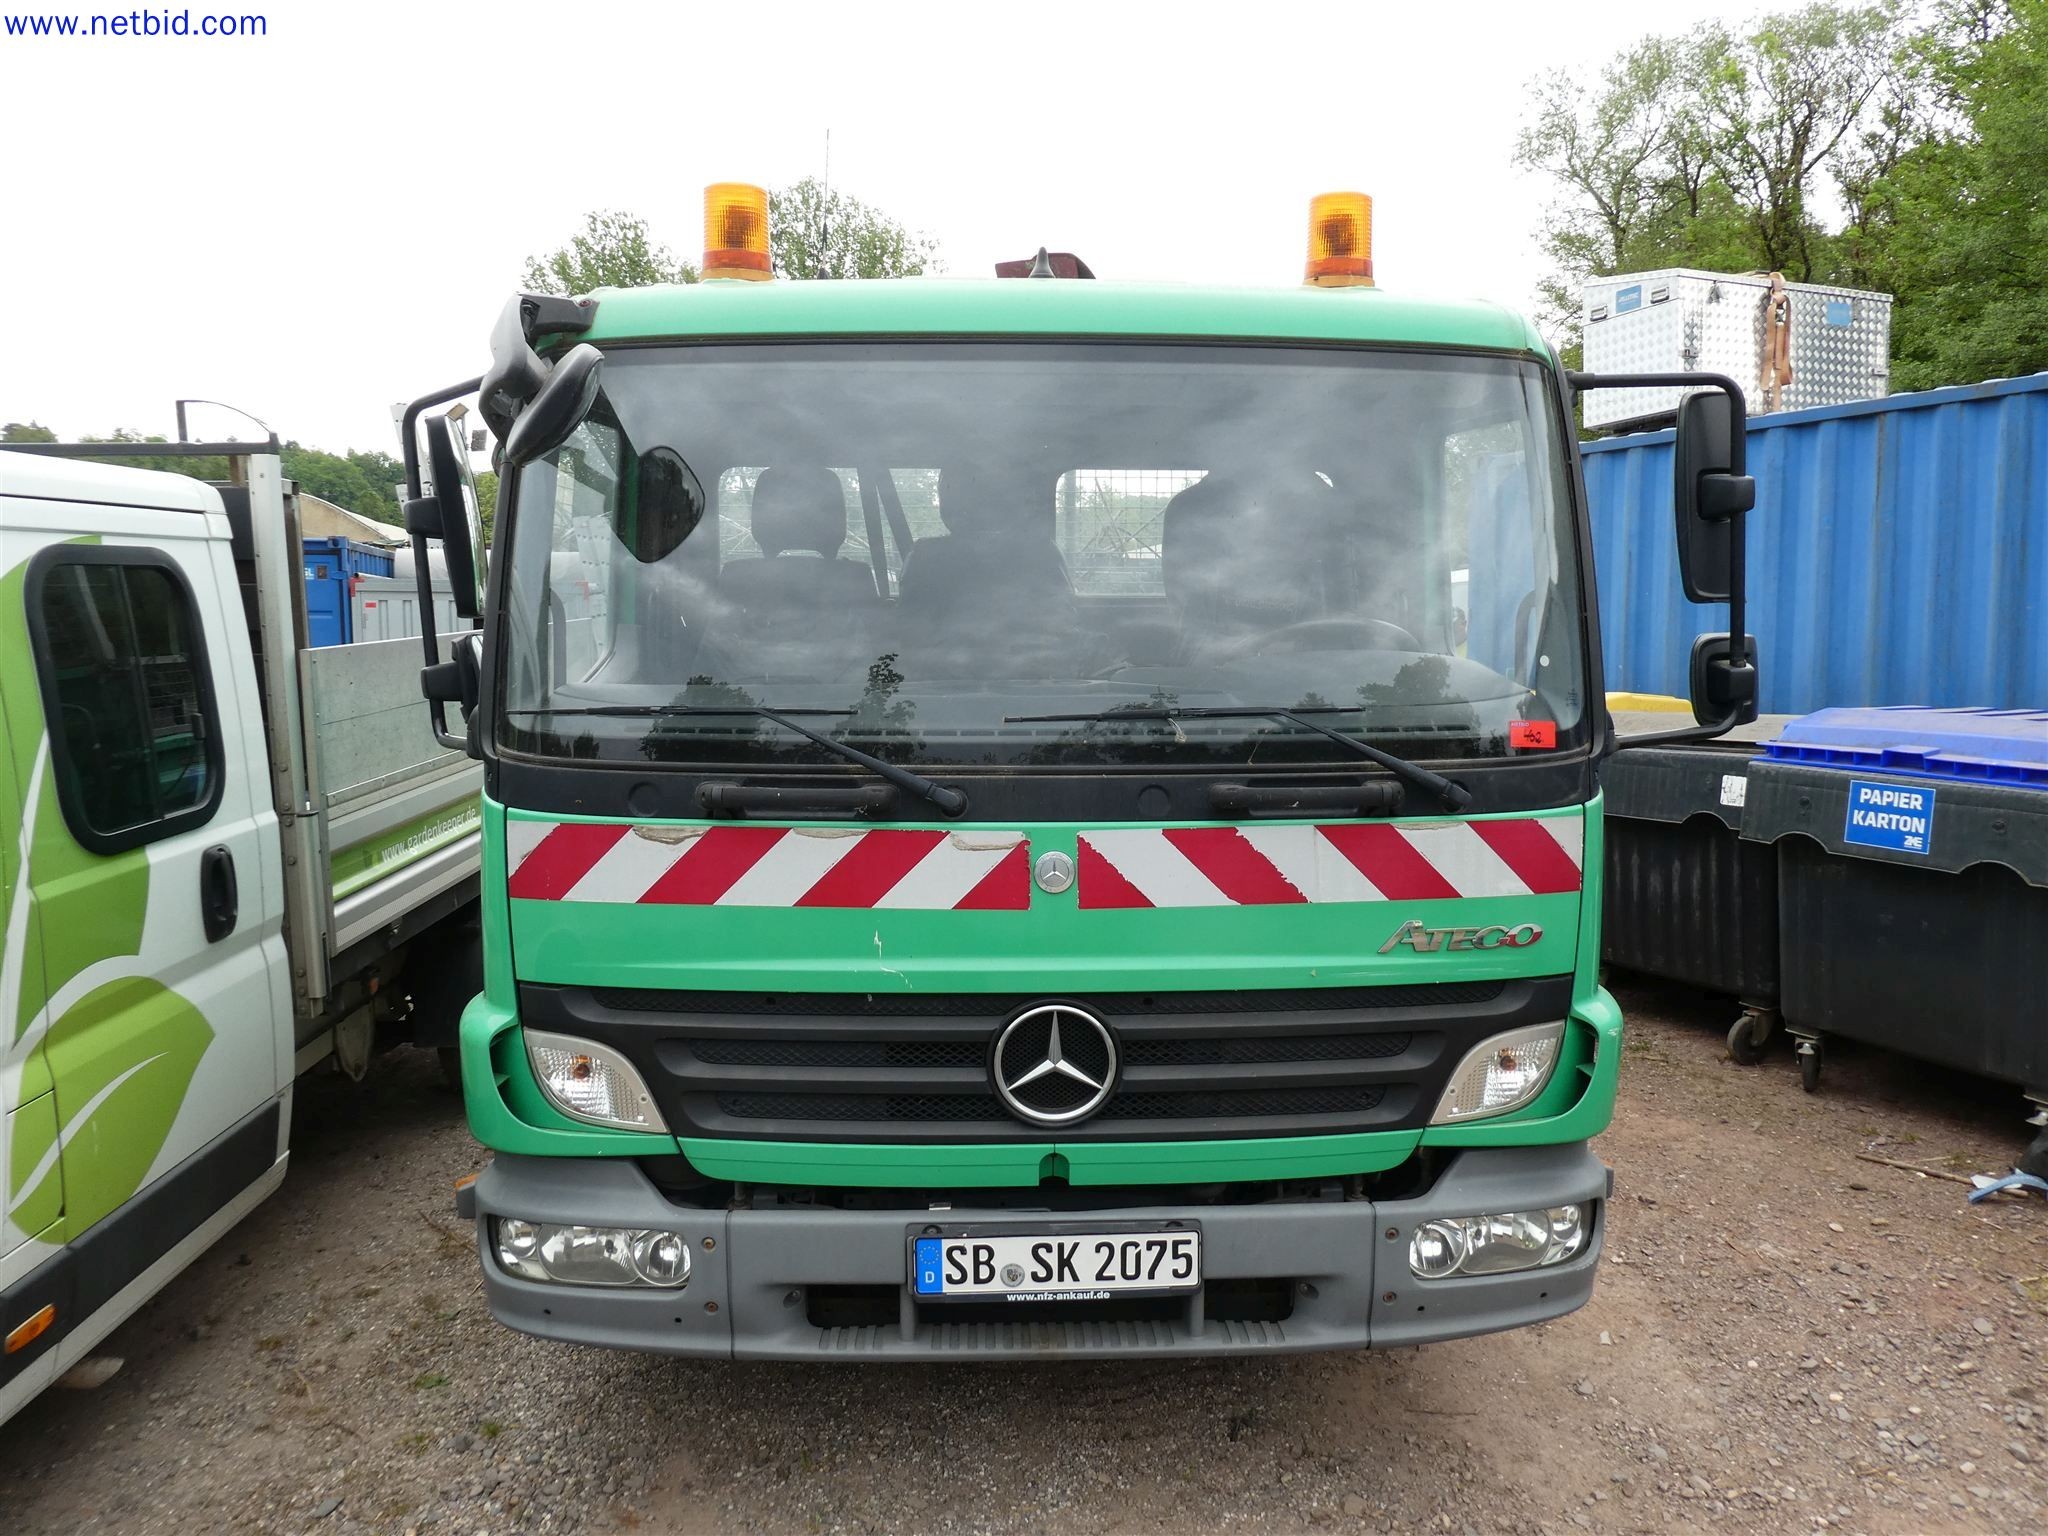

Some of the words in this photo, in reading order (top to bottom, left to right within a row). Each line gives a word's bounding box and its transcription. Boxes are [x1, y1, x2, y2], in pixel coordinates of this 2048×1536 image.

[1859, 787, 1922, 810] PAPIER
[381, 805, 476, 863] www.gardenkeeper.de
[1853, 809, 1926, 834] KARTON
[1378, 920, 1544, 953] ATEGO
[945, 1244, 996, 1285] SB
[1031, 1242, 1080, 1283] SK
[1094, 1239, 1193, 1281] 2075
[925, 1271, 934, 1283] D
[1007, 1291, 1110, 1302] www.nfz-ankauf.de
